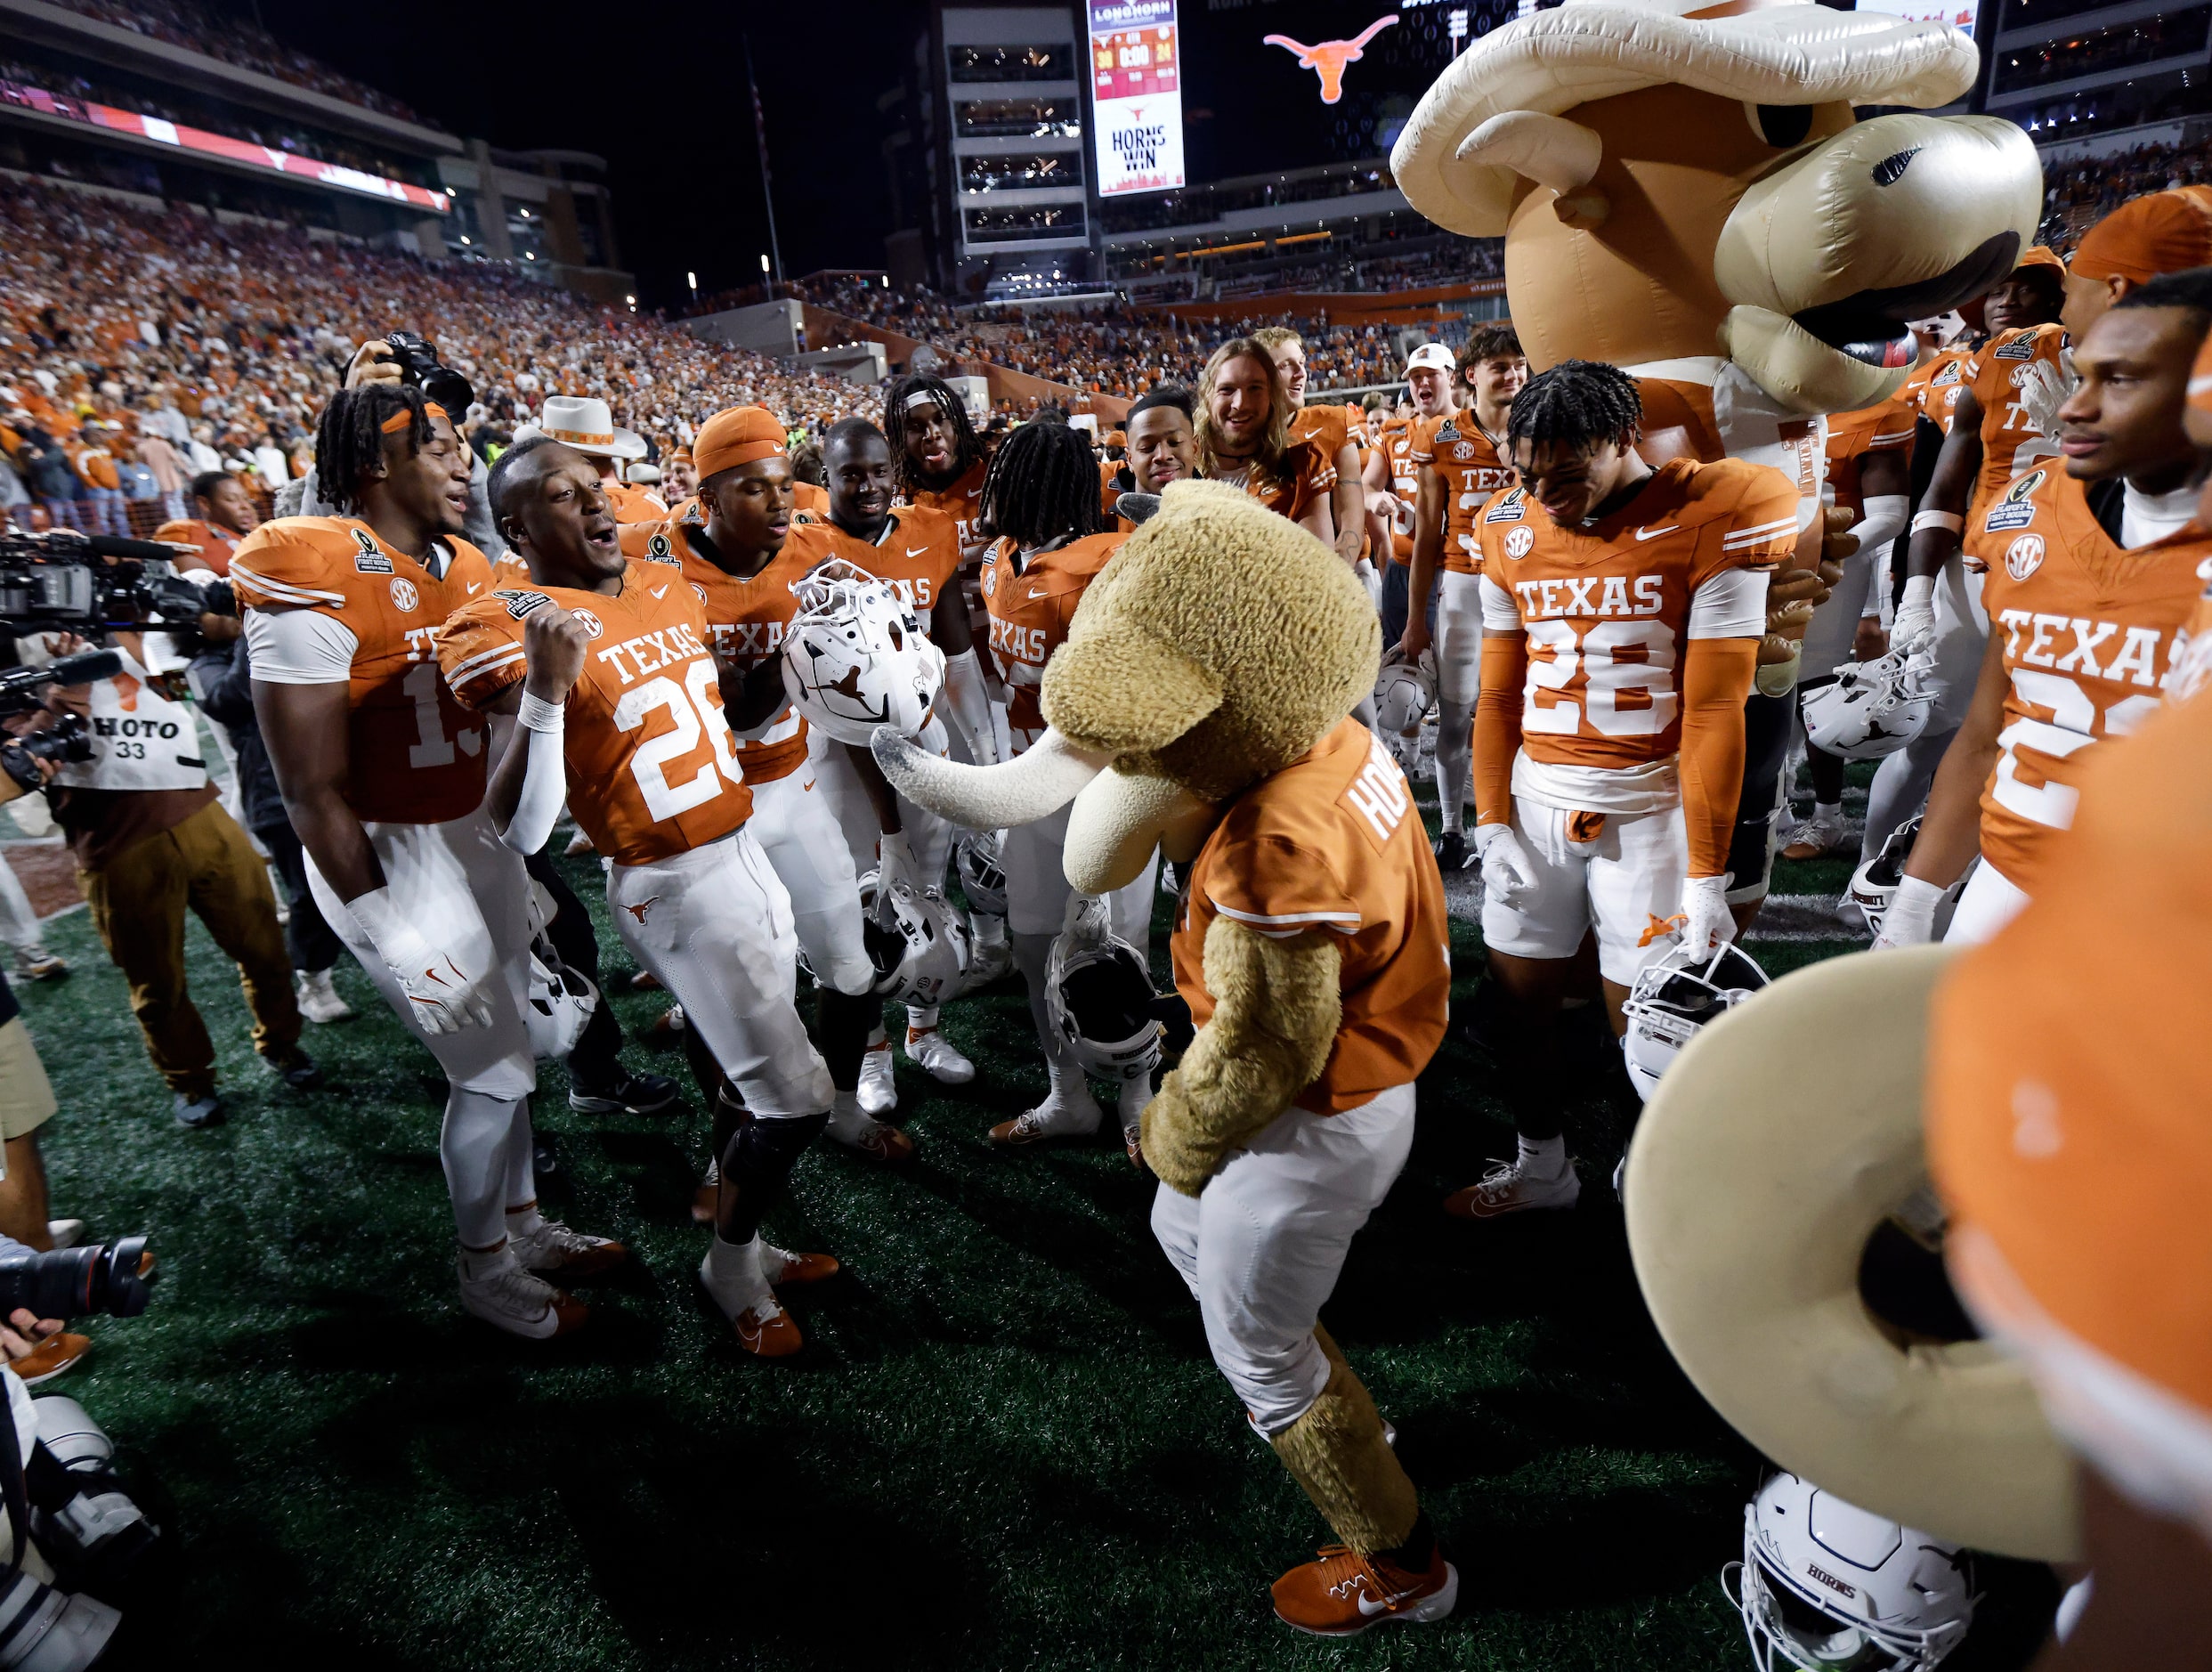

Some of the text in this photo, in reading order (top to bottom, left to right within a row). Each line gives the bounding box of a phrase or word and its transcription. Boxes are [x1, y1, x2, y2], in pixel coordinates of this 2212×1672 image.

[1095, 1, 1171, 22] LONGHORN
[1112, 125, 1165, 150] HORNS
[1124, 149, 1155, 171] WIN
[1394, 459, 1419, 475] TE
[1462, 468, 1516, 490] TEX
[1989, 510, 2031, 523] FIRST ROUND
[1996, 503, 2028, 514] PLAYOFF
[1507, 527, 1532, 557] SEC
[2009, 537, 2042, 578] SEC
[392, 579, 417, 610] SEC
[1516, 575, 1663, 617] TEXAS
[597, 623, 708, 685] TEXAS
[1522, 620, 1678, 735] 28
[116, 741, 145, 759] 33
[1807, 1563, 1856, 1599] HORNS
